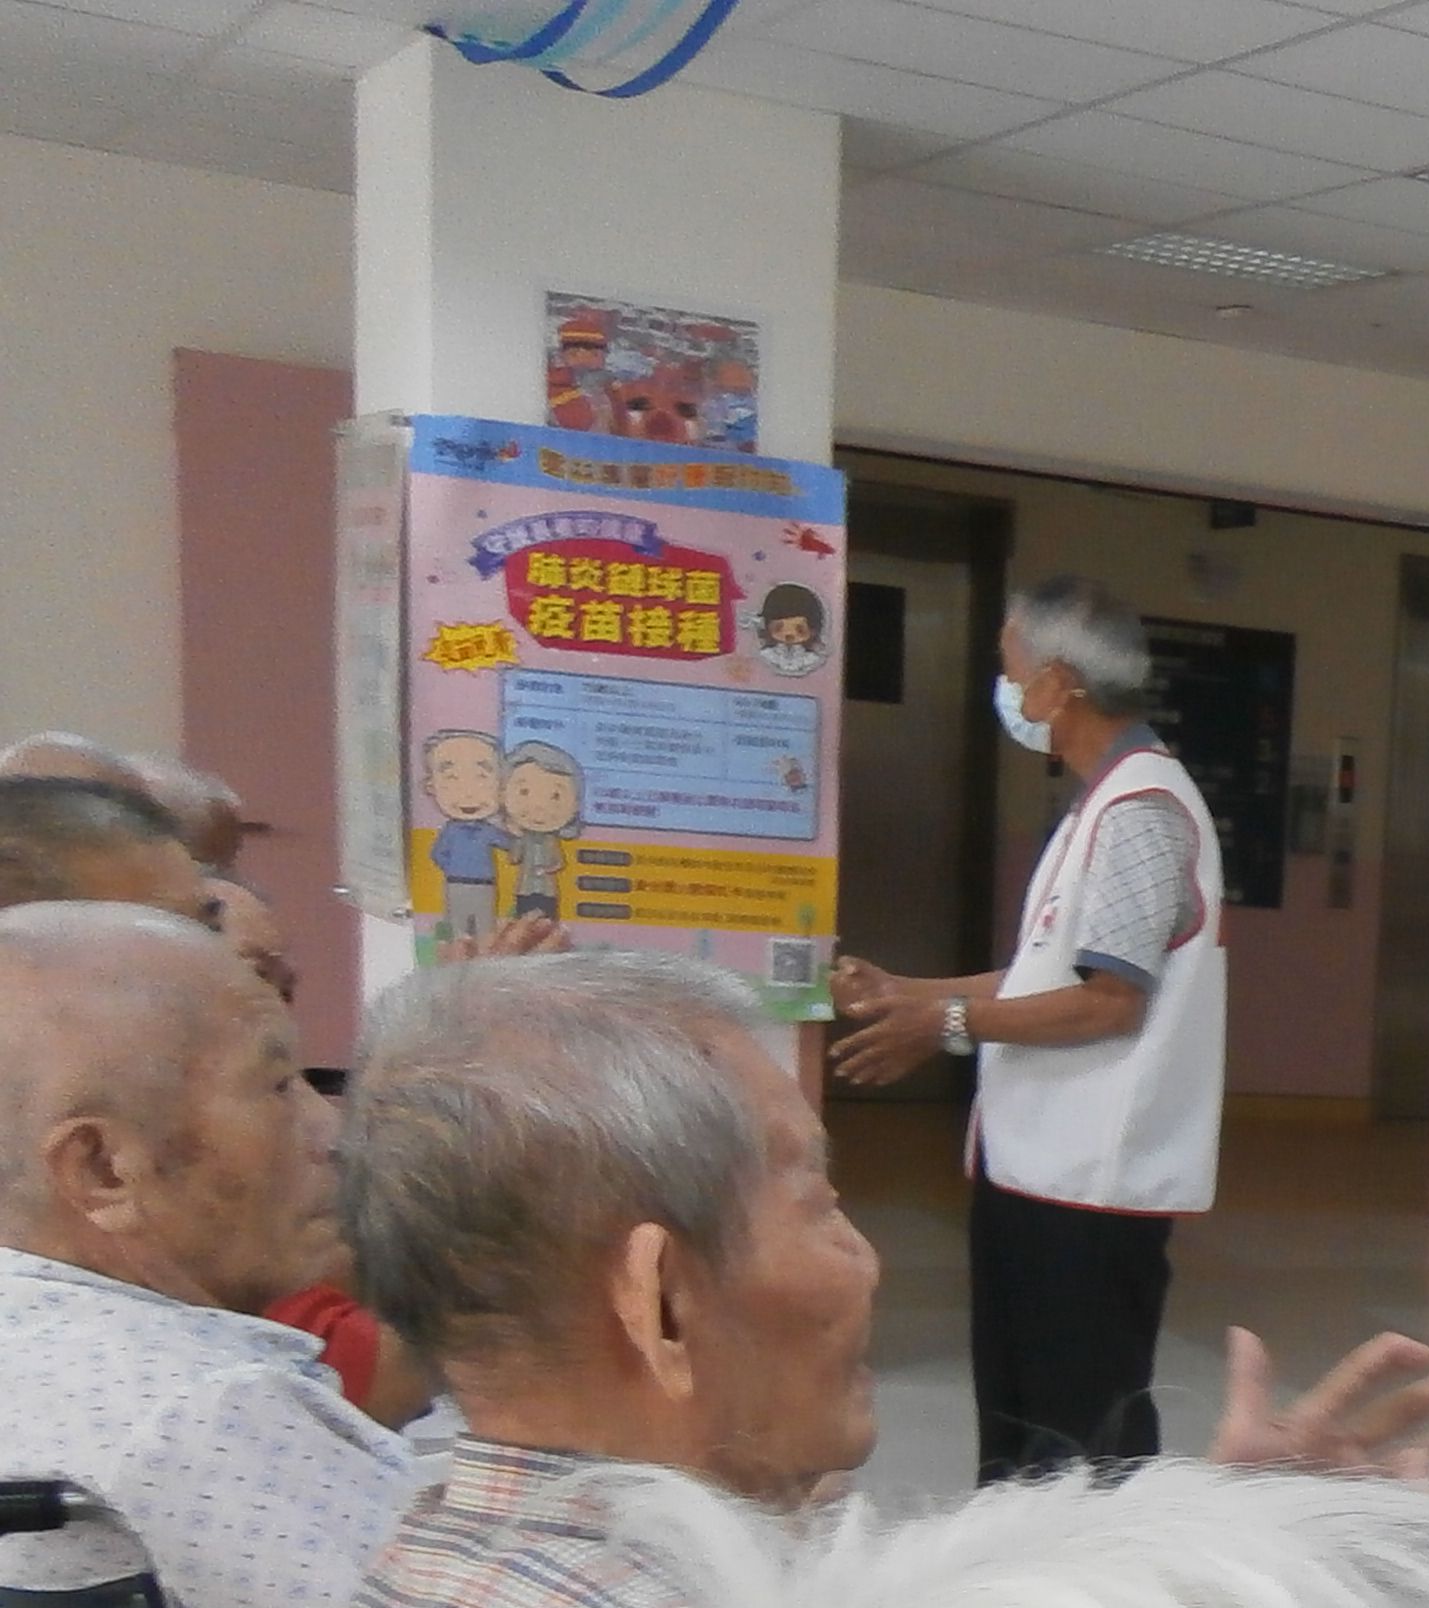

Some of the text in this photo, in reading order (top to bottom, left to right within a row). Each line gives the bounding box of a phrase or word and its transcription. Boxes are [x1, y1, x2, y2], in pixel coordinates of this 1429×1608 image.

[527, 553, 721, 606] 肺炎鏈球菌
[528, 594, 721, 654] 疫苗接種
